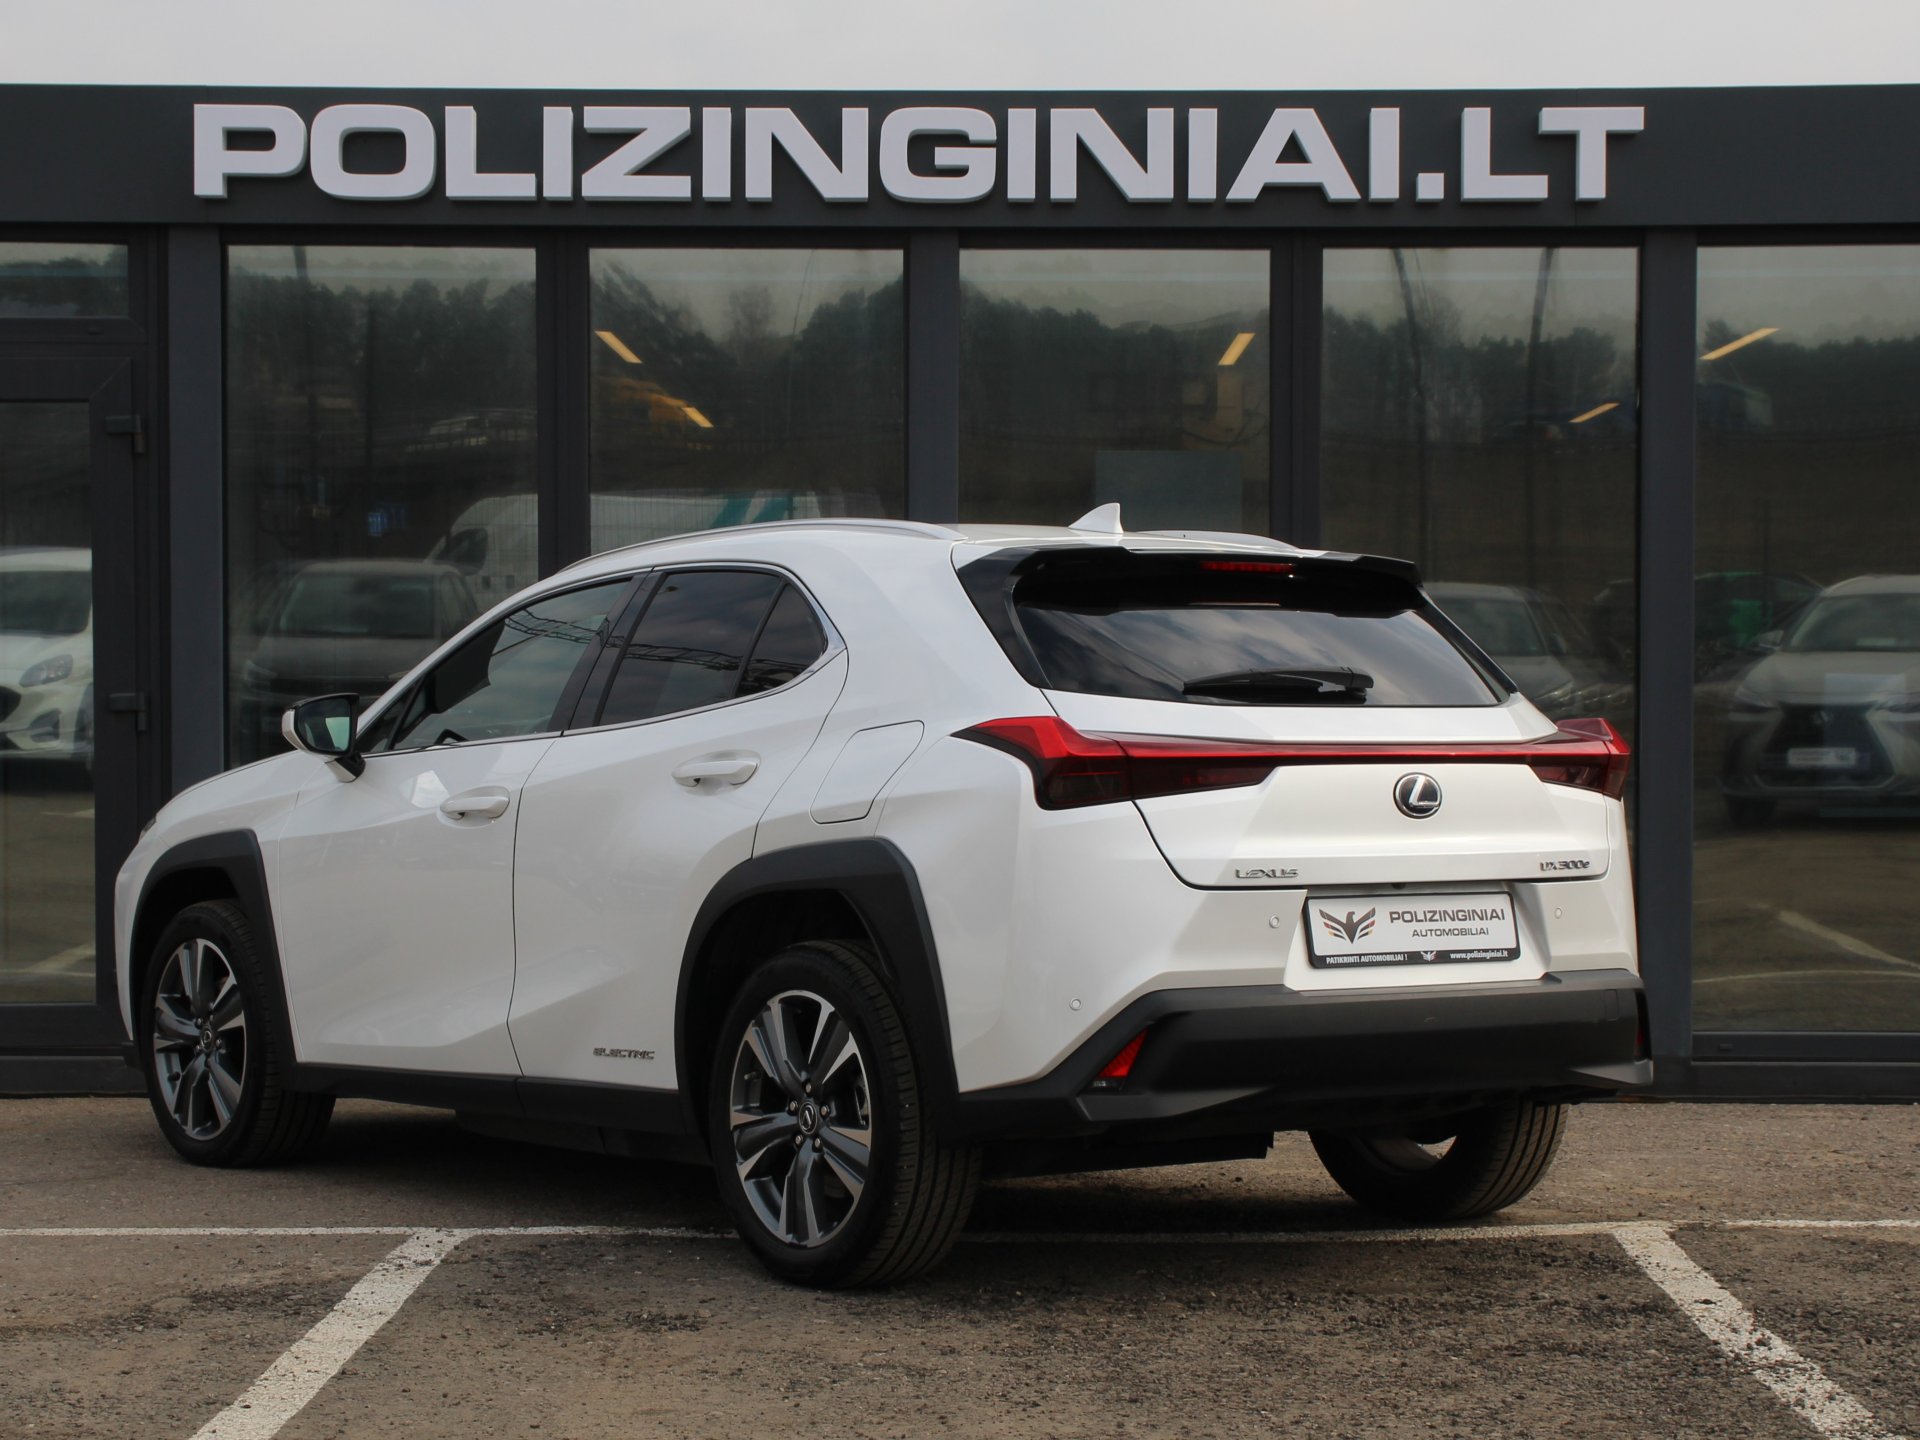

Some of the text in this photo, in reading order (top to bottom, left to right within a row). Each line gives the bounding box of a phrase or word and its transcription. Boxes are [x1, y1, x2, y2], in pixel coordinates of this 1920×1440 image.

[193, 103, 1645, 202] POLIZINGINIAI.LT
[1235, 868, 1299, 879] LEXUS
[1389, 908, 1506, 924] POLIZINGINIAI
[1411, 927, 1489, 938] AUTOMOBILIAI
[1326, 955, 1360, 965] PATIKRINTI
[1360, 953, 1404, 963] AUTOMOBILIAI
[1450, 950, 1509, 960] www.polizinginiai.lt
[593, 1047, 656, 1060] ELECTRIC
